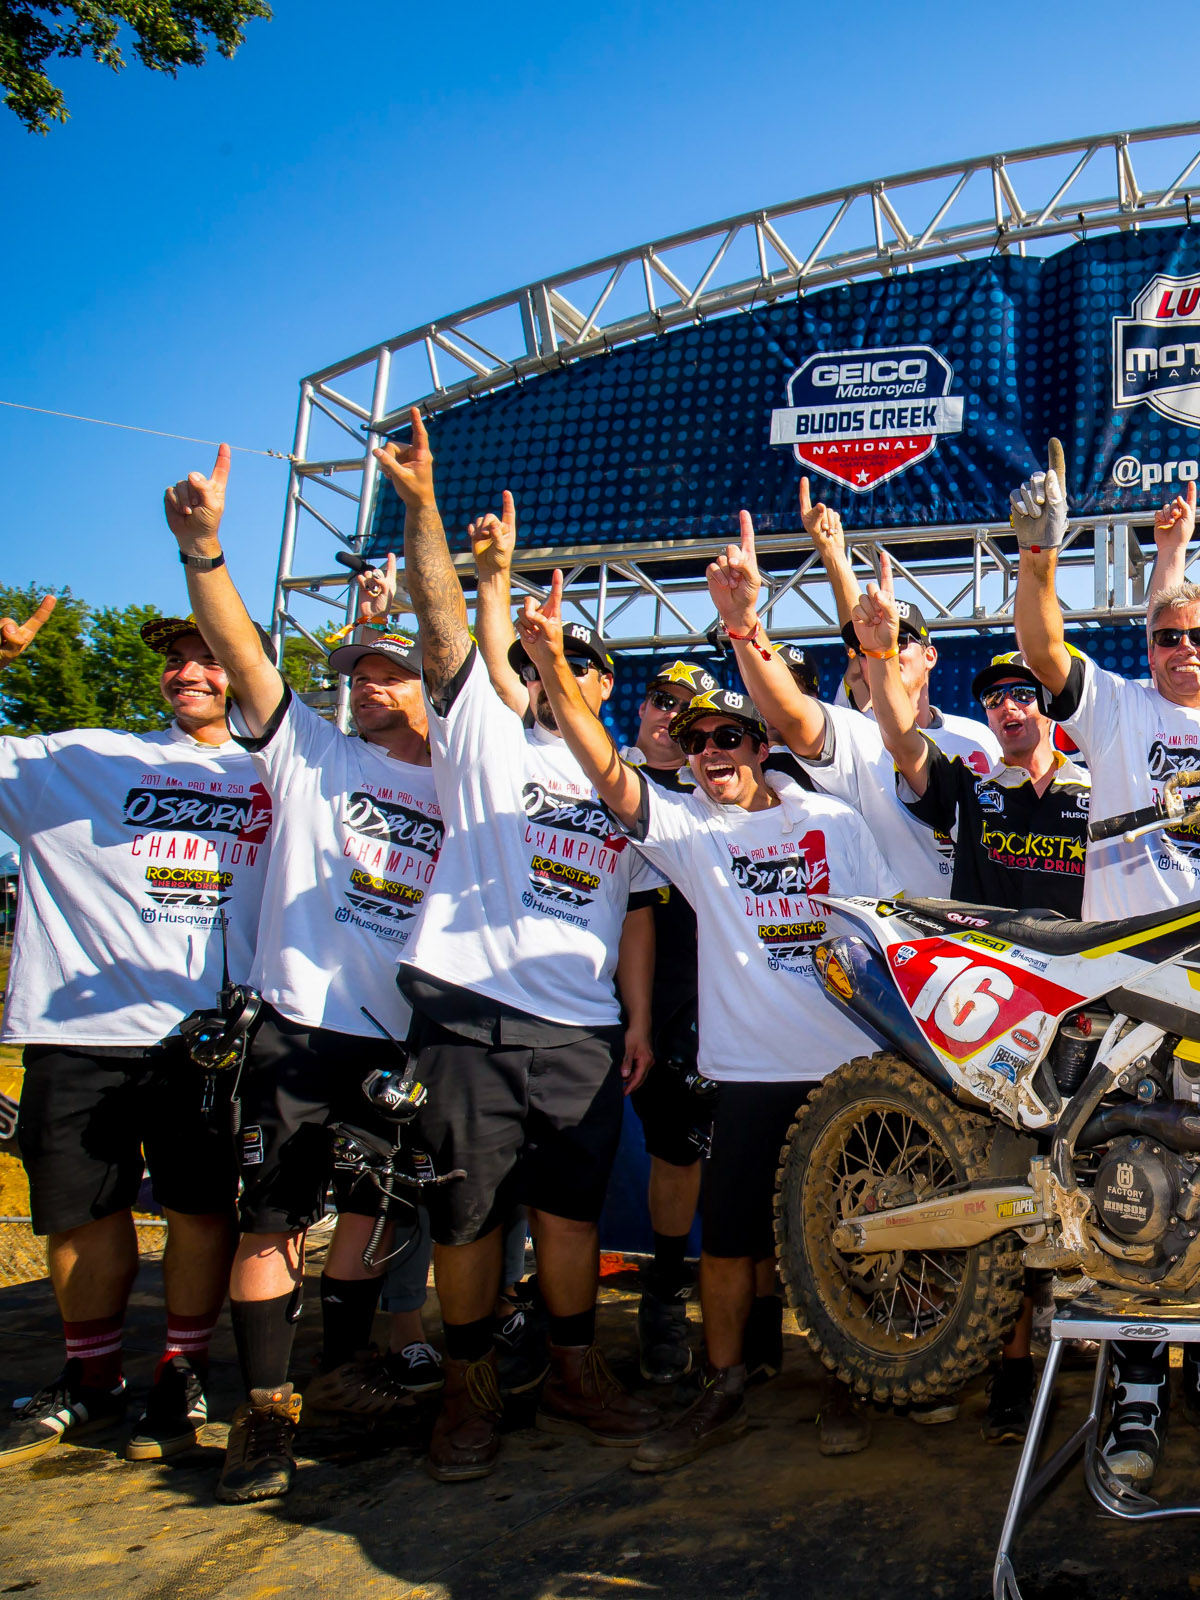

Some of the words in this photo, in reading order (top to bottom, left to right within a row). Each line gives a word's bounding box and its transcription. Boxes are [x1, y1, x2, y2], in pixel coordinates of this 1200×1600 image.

[812, 359, 927, 387] GEICO
[835, 380, 926, 398] Motorcycle
[796, 410, 865, 434] BUDDS
[870, 405, 937, 430] CREEK
[812, 440, 918, 454] NATIONAL
[1168, 736, 1181, 746] AMA
[1184, 734, 1197, 745] PRO
[140, 775, 161, 786] 2017
[188, 782, 205, 791] PRO
[210, 782, 222, 792] MX
[228, 784, 244, 794] 250
[376, 787, 392, 800] AMA
[398, 792, 412, 805] PRO
[428, 804, 441, 815] 250
[125, 792, 272, 834] OSBORNE
[132, 834, 258, 866] CHAMPION
[524, 824, 618, 874] CHAMPION
[752, 848, 765, 860] PRO
[768, 845, 778, 856] MX
[781, 843, 795, 854] 250
[152, 880, 192, 888] ENERGY
[344, 891, 416, 920] FLY
[532, 900, 590, 927] Husqvarna
[350, 914, 409, 940] Husqvarna
[947, 912, 990, 927] GUTS
[1019, 952, 1048, 969] Husqvarna
[911, 956, 1014, 1043] 16
[1107, 1185, 1144, 1199] FACTORY
[964, 1200, 987, 1216] RK
